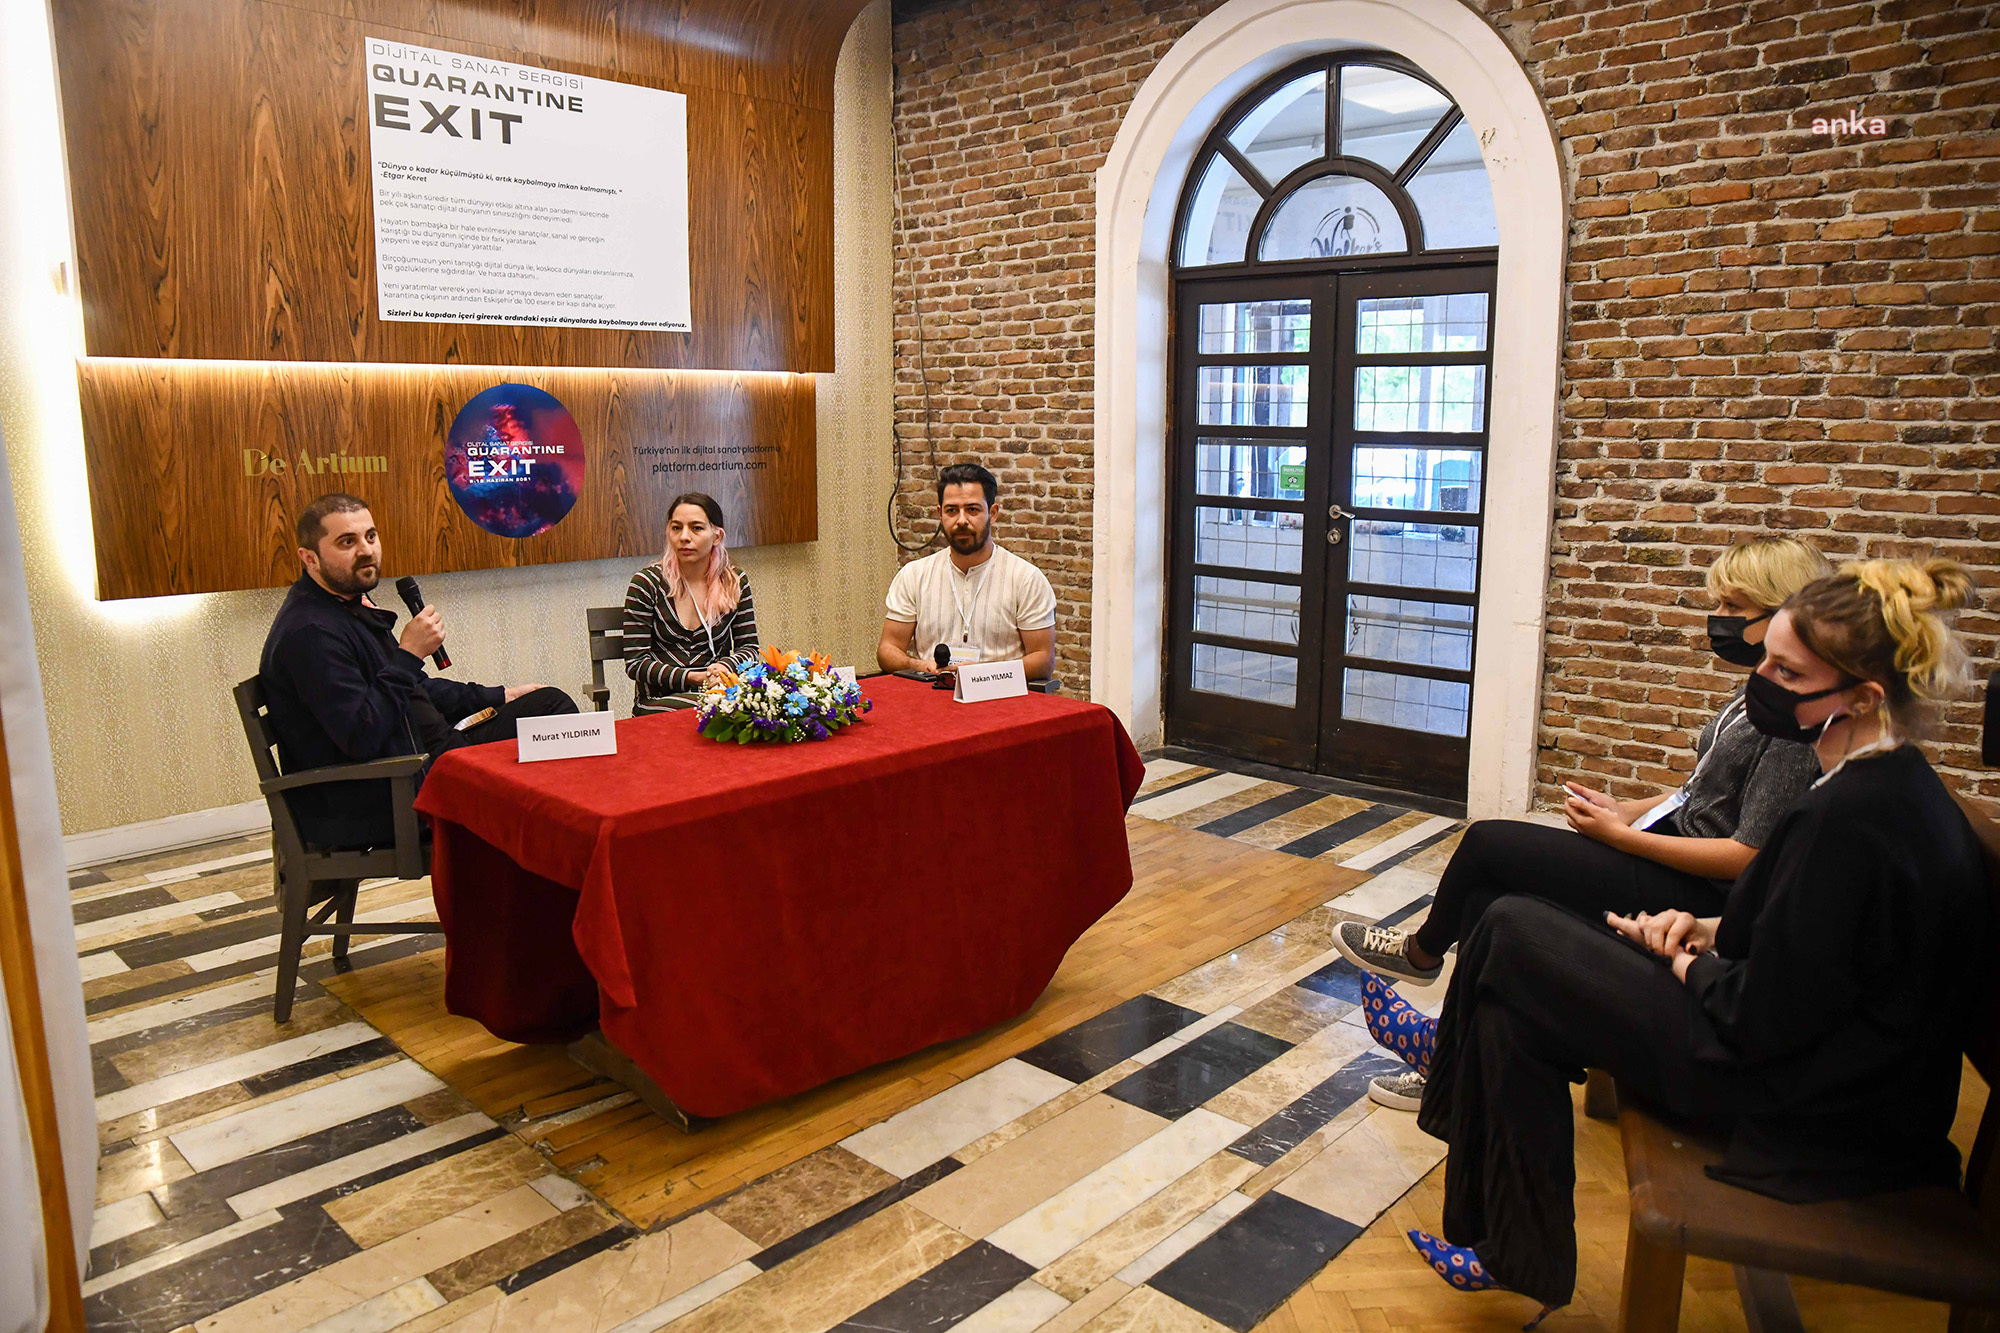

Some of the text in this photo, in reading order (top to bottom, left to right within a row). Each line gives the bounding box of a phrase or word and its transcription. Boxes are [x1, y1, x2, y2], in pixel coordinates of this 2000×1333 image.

[372, 43, 584, 89] DİJİTAL SANAT SERGİSİ
[372, 64, 584, 113] QUARANTINE
[374, 93, 522, 144] EXIT
[407, 174, 427, 182] Keret
[416, 166, 438, 174] kadar
[440, 168, 483, 179] küçülmüştü
[514, 177, 556, 188] kaybolmaya
[558, 182, 578, 190] imkan
[410, 203, 436, 211] sanatçı
[458, 207, 491, 215] dünyanın
[424, 194, 448, 202] süredir
[467, 198, 494, 208] dünyayı
[549, 207, 578, 215] pandemi
[381, 227, 410, 236] karıştığı
[423, 230, 456, 239] dünyanın
[459, 233, 479, 241] içinde
[411, 220, 448, 229] bambaşka
[477, 227, 516, 235] evrilmesiyle
[440, 241, 470, 250] dünyalar
[382, 254, 436, 264] Birçoğumuzun
[455, 260, 482, 268] tanıştığı
[504, 263, 524, 271] dünya
[536, 265, 561, 273] koskoca
[563, 267, 592, 275] dünyaları
[395, 265, 439, 273] gözlüklerine
[420, 293, 449, 301] çıkışının
[425, 311, 456, 319] kapıdan
[459, 312, 475, 320] içeri
[559, 317, 597, 325] dünyalarda
[467, 445, 564, 456] QUARANTINE
[633, 445, 781, 457] Türkiye'nin ilk dijital sanat platformu
[243, 448, 388, 477] De Artium
[468, 459, 536, 477] EXIT
[652, 460, 767, 475] platform.deartium.com
[971, 672, 1013, 683] Hakan YILMAZ
[532, 728, 600, 741] Murat YILDIRIM
